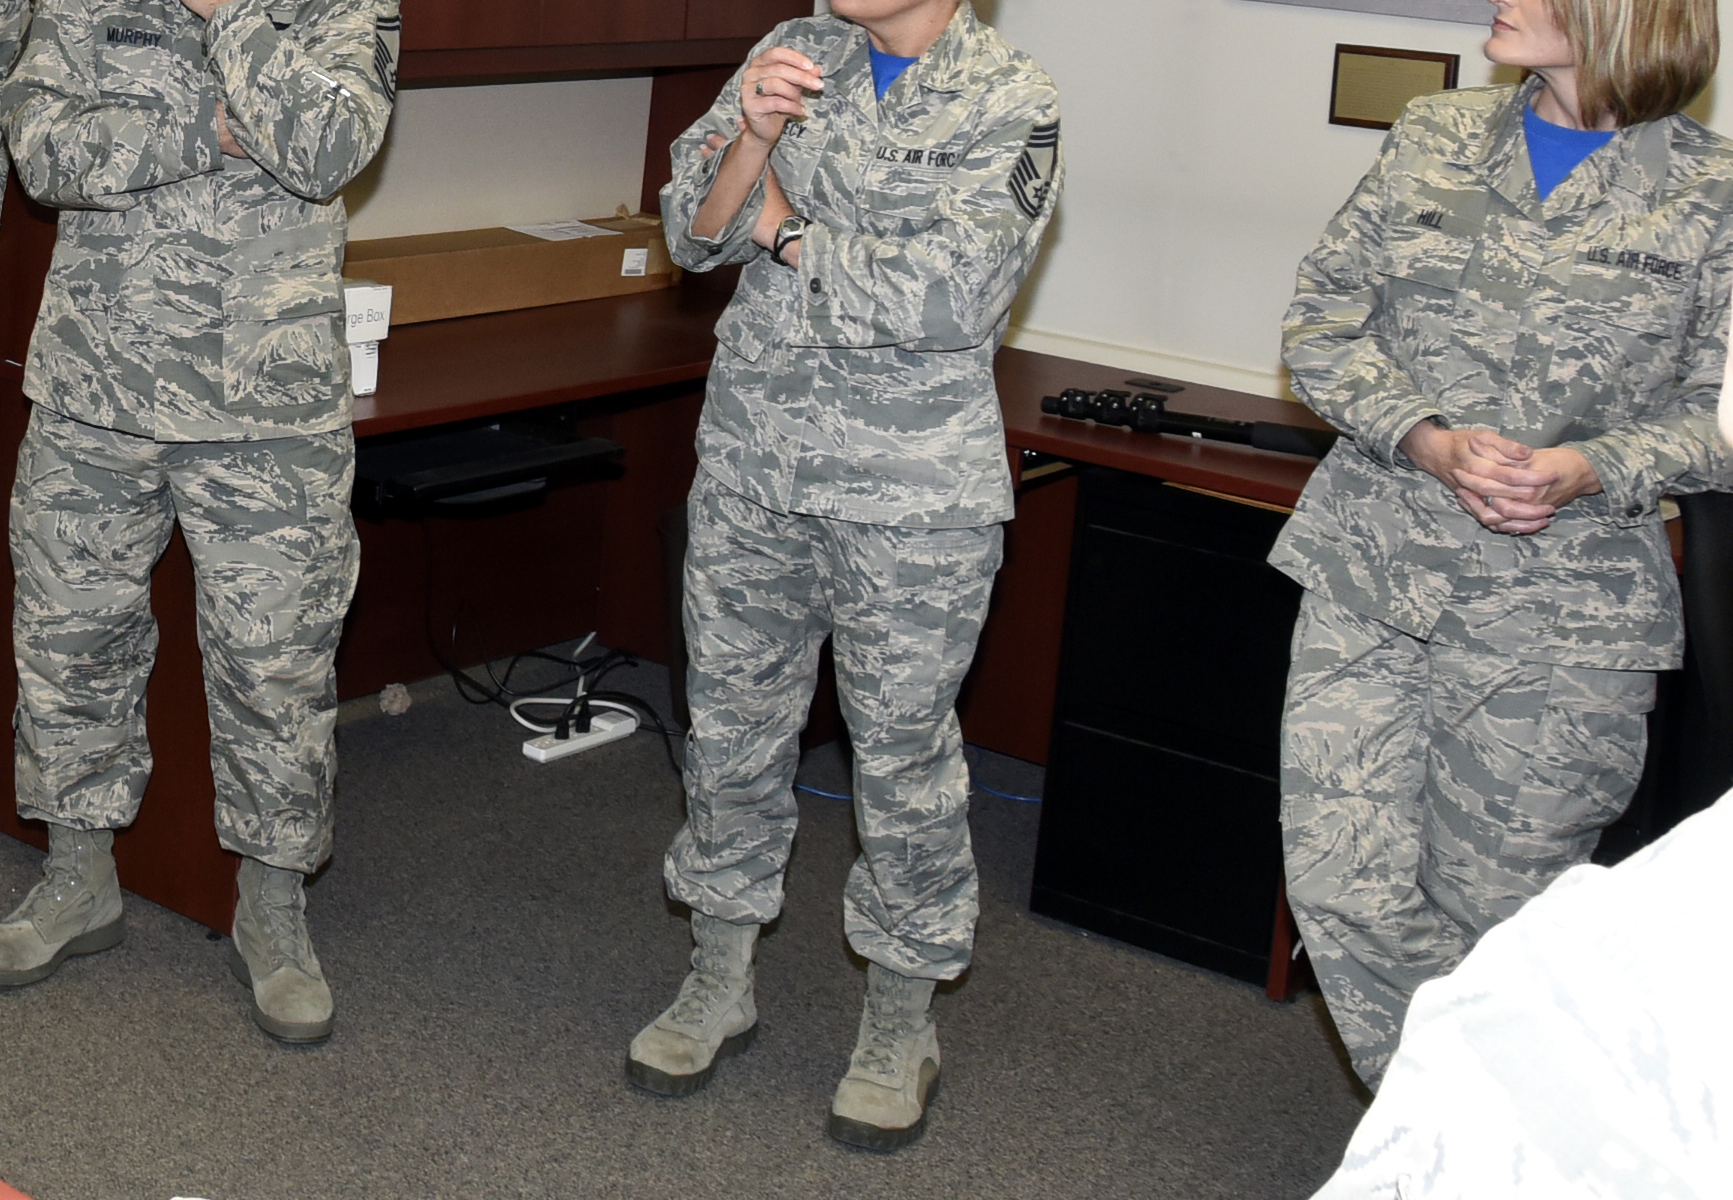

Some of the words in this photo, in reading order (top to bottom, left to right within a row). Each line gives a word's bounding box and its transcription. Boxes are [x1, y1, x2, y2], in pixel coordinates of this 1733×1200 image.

[106, 26, 162, 47] MURPHY
[876, 145, 899, 163] U.S.
[902, 150, 922, 165] AIR
[1416, 209, 1443, 229] HILL
[1587, 246, 1611, 265] U.S.
[1615, 251, 1640, 270] AIR
[1642, 255, 1684, 281] FORCE
[348, 312, 364, 328] rge
[366, 308, 385, 323] Box
